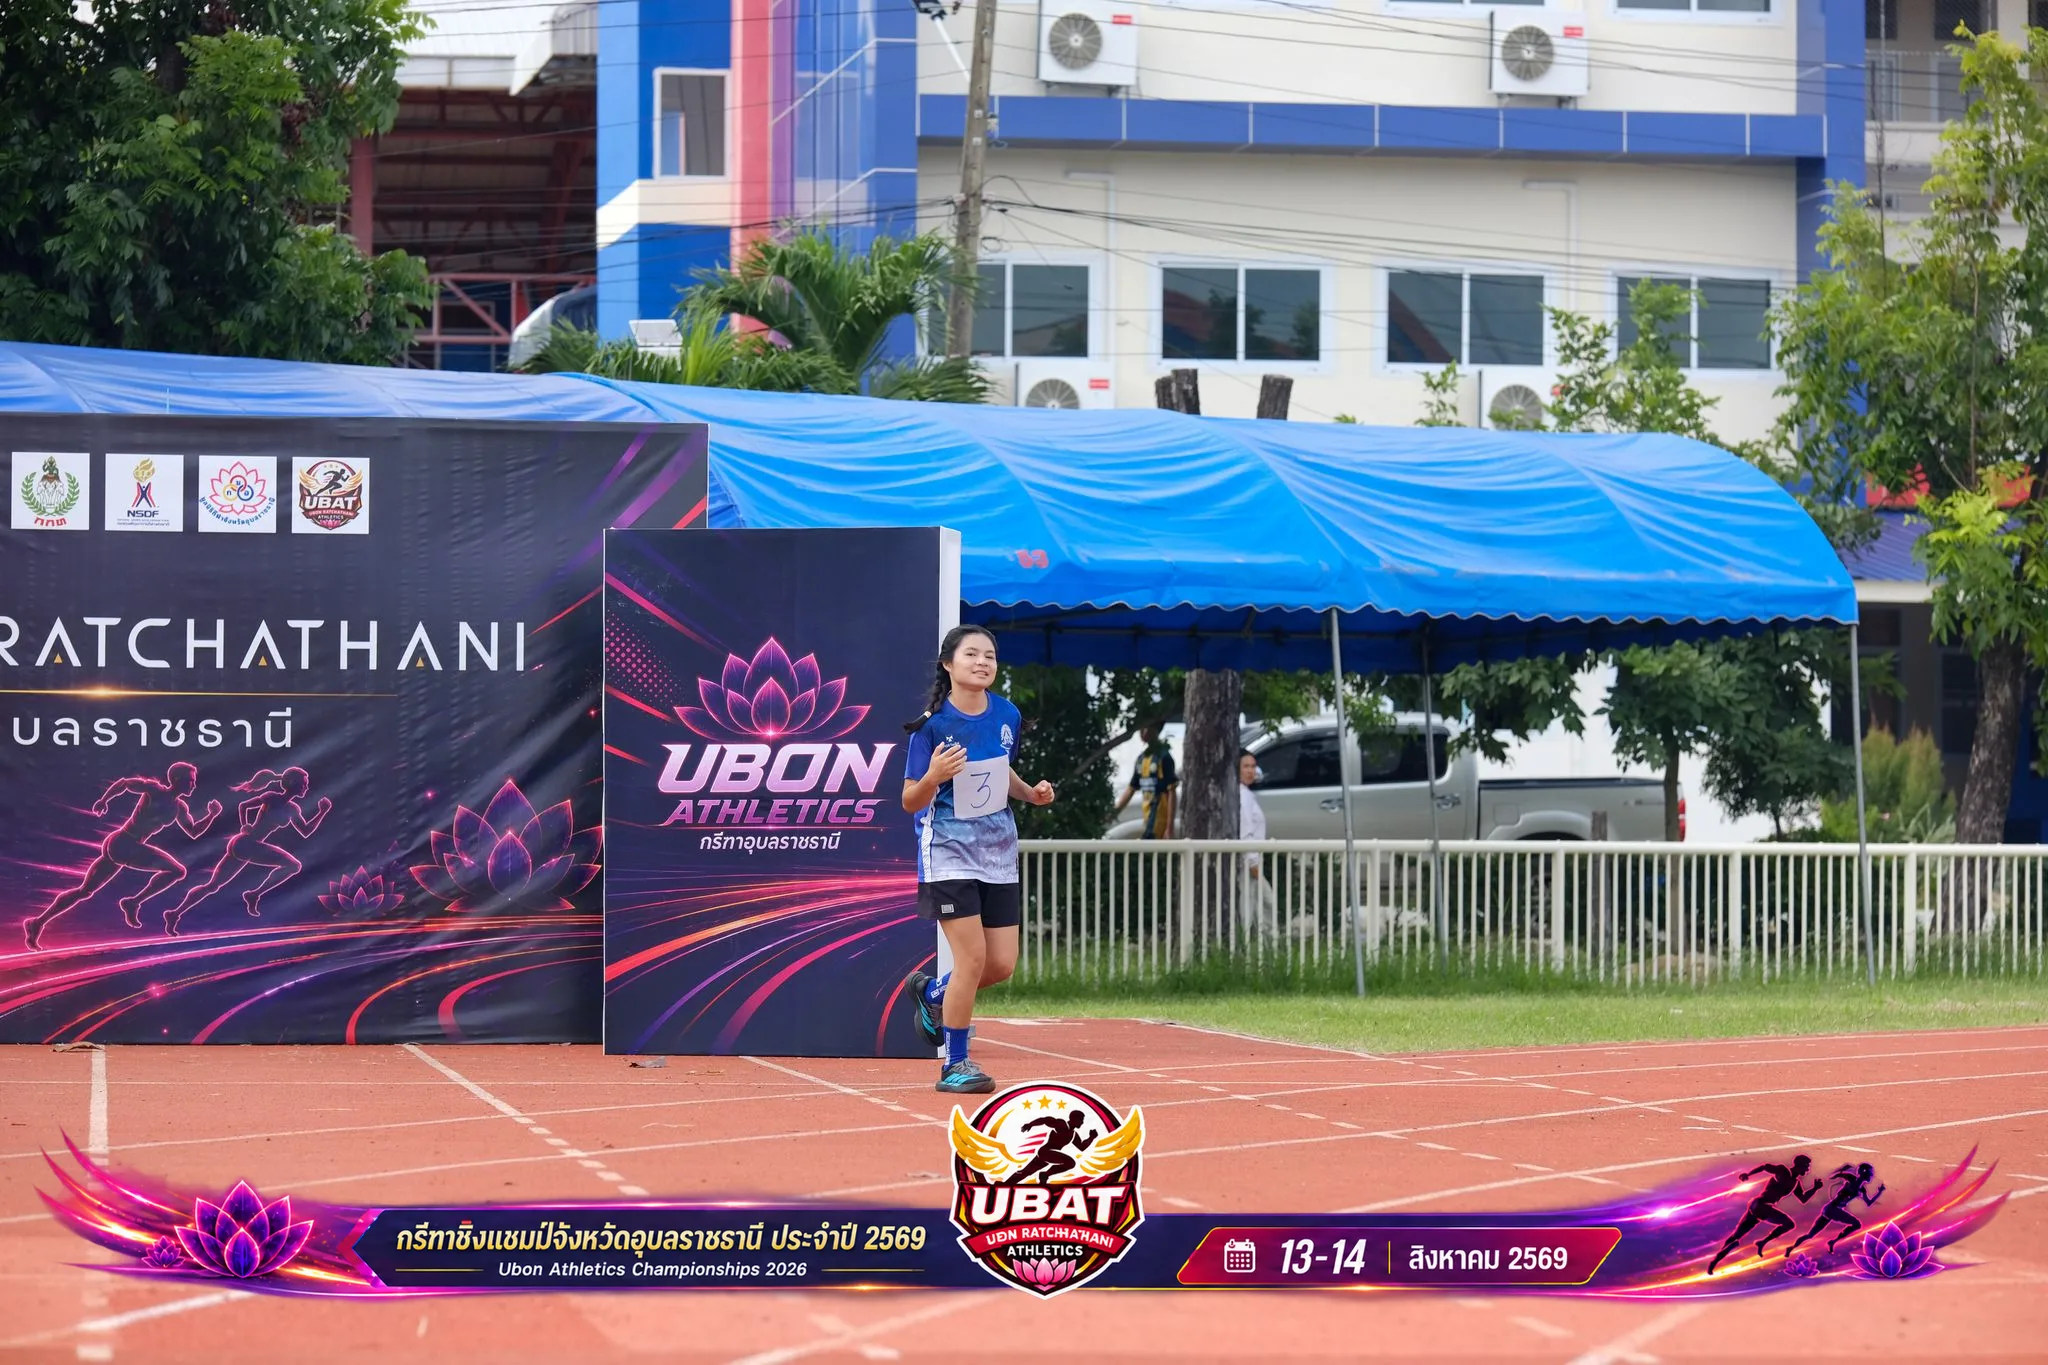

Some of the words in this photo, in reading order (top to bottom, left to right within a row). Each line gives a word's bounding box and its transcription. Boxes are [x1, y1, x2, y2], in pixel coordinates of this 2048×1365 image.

[127, 510, 159, 518] NSDF
[304, 496, 358, 510] UBAT
[0, 616, 525, 671] RATCHATHANI
[658, 743, 898, 793] UBON
[970, 771, 992, 809] 3
[656, 799, 885, 827] ATHLETICS
[700, 831, 842, 855] กรีฑาอุบลราชธานี
